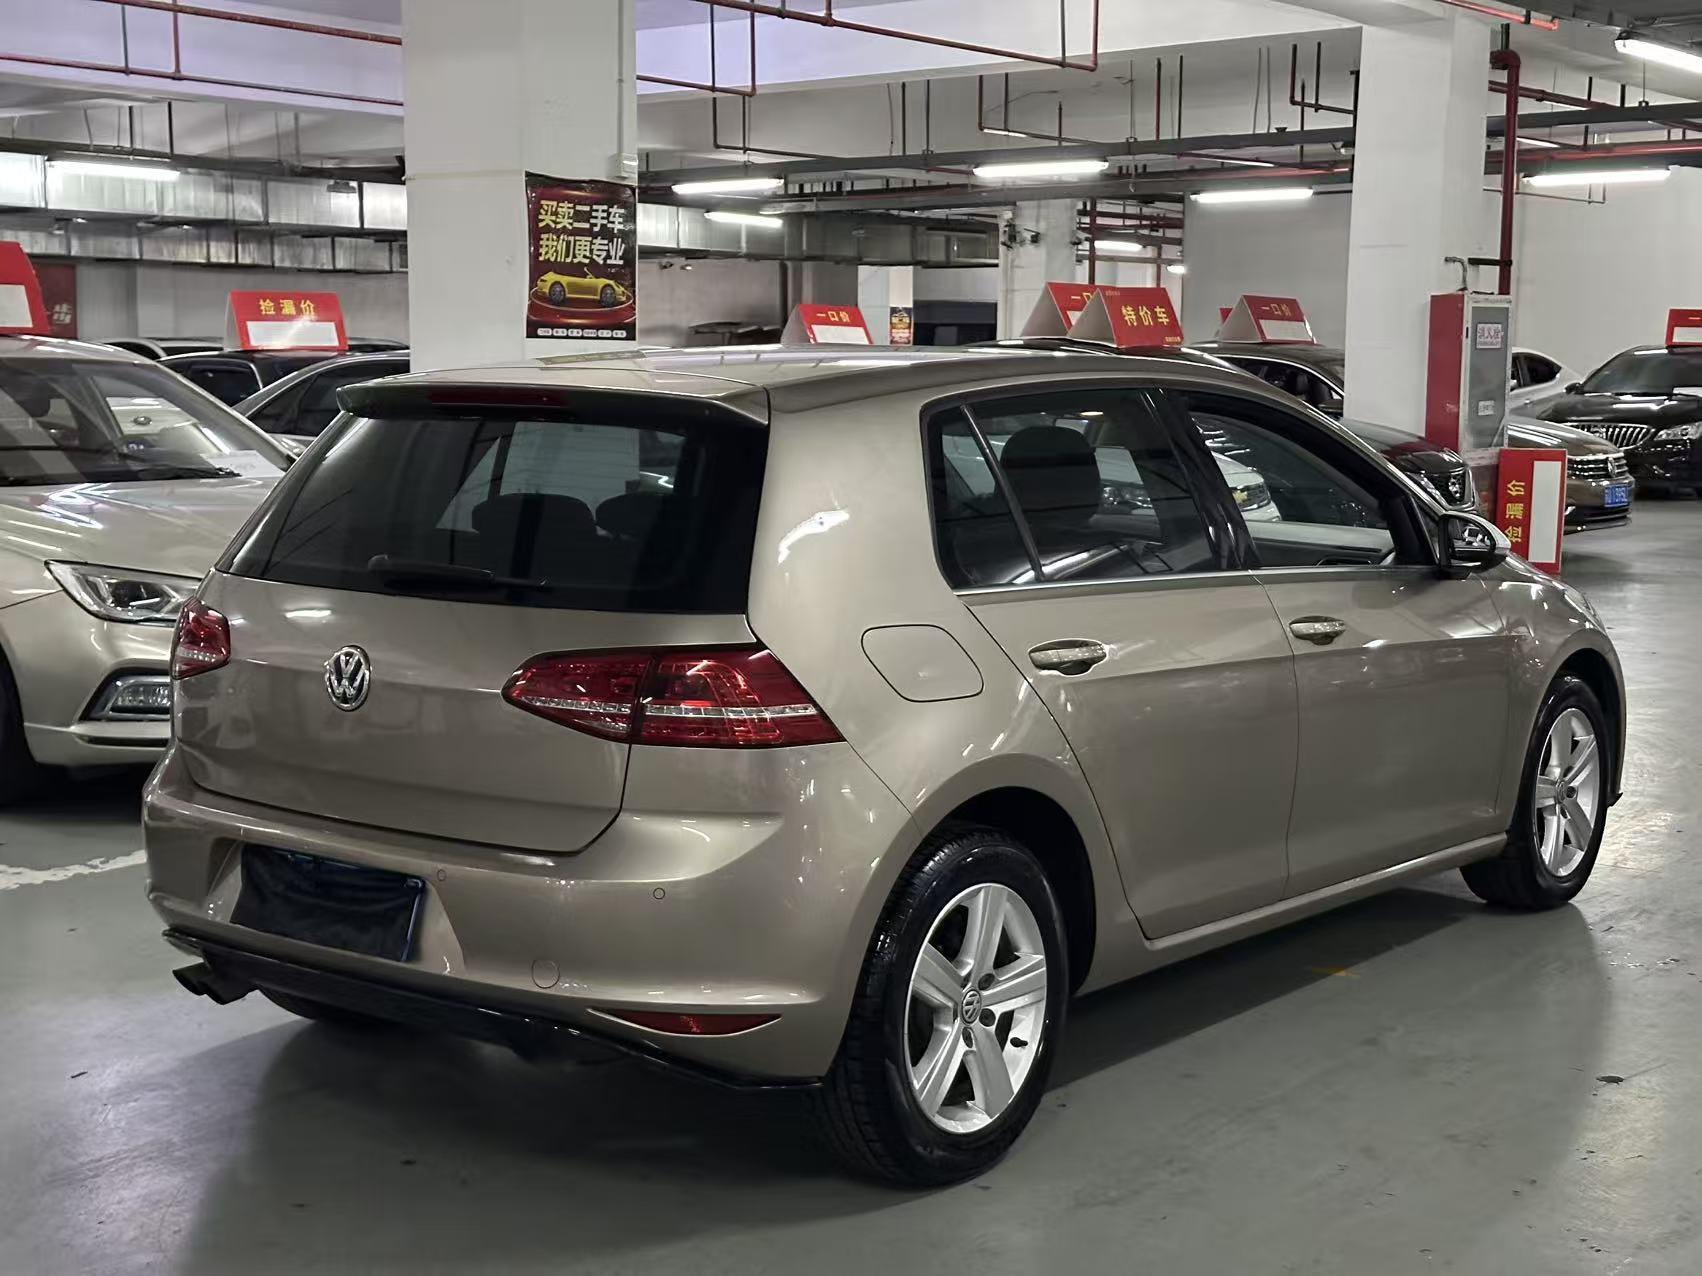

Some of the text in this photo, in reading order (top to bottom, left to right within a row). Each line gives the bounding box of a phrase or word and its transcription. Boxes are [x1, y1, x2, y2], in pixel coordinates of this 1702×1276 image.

[538, 200, 626, 233] 买卖二手车
[538, 233, 626, 265] 我们更专业
[259, 299, 316, 317] 捡漏价
[816, 311, 850, 323] 一口价
[1121, 305, 1170, 326] 特价车
[1260, 303, 1292, 317] 一口价
[1504, 480, 1525, 543] 捡漏价
